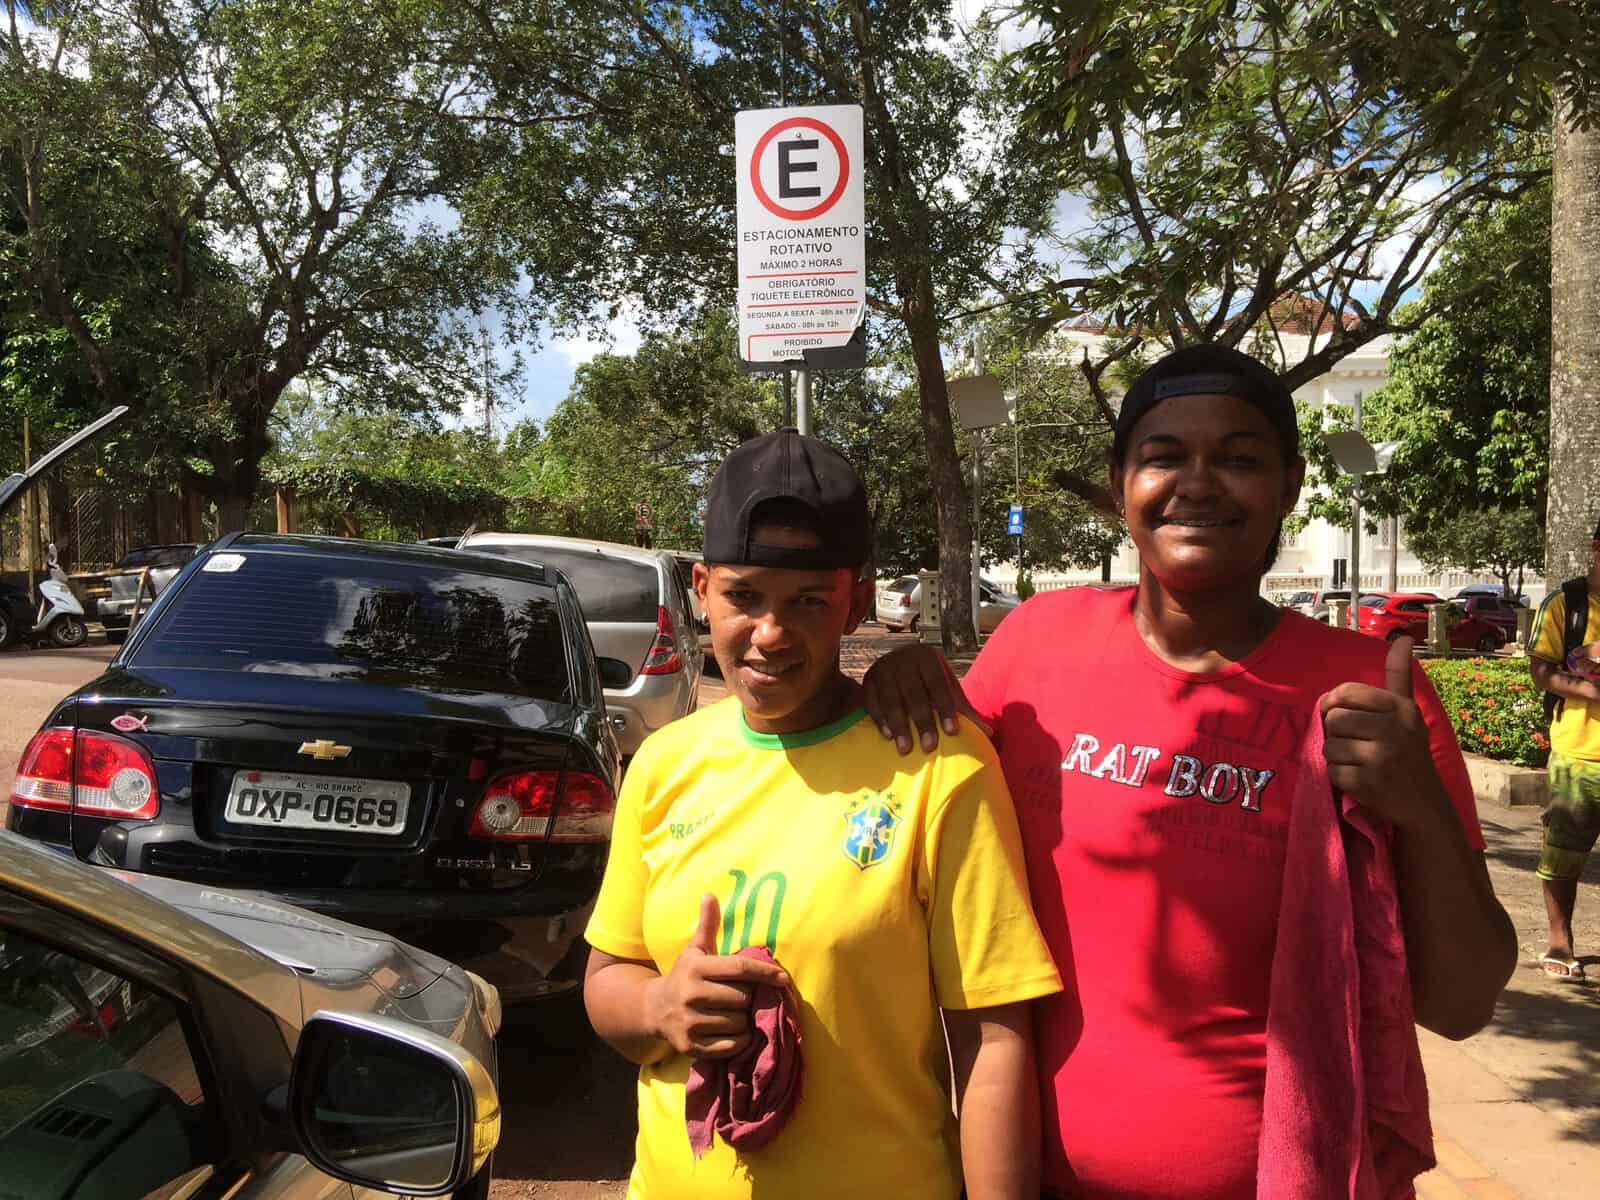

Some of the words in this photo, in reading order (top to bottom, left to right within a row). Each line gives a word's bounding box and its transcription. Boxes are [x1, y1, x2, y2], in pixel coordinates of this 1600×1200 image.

[778, 138, 821, 199] E
[744, 226, 859, 242] ESTACIONAMENTO
[770, 243, 832, 256] ROTATIVO
[801, 260, 807, 268] 2
[809, 258, 843, 267] HORAS
[793, 288, 854, 299] ELETRÔNICO
[784, 338, 823, 347] PROIBIDO
[1061, 732, 1160, 788] RAT
[1163, 754, 1275, 812] BOY
[719, 868, 787, 957] 10
